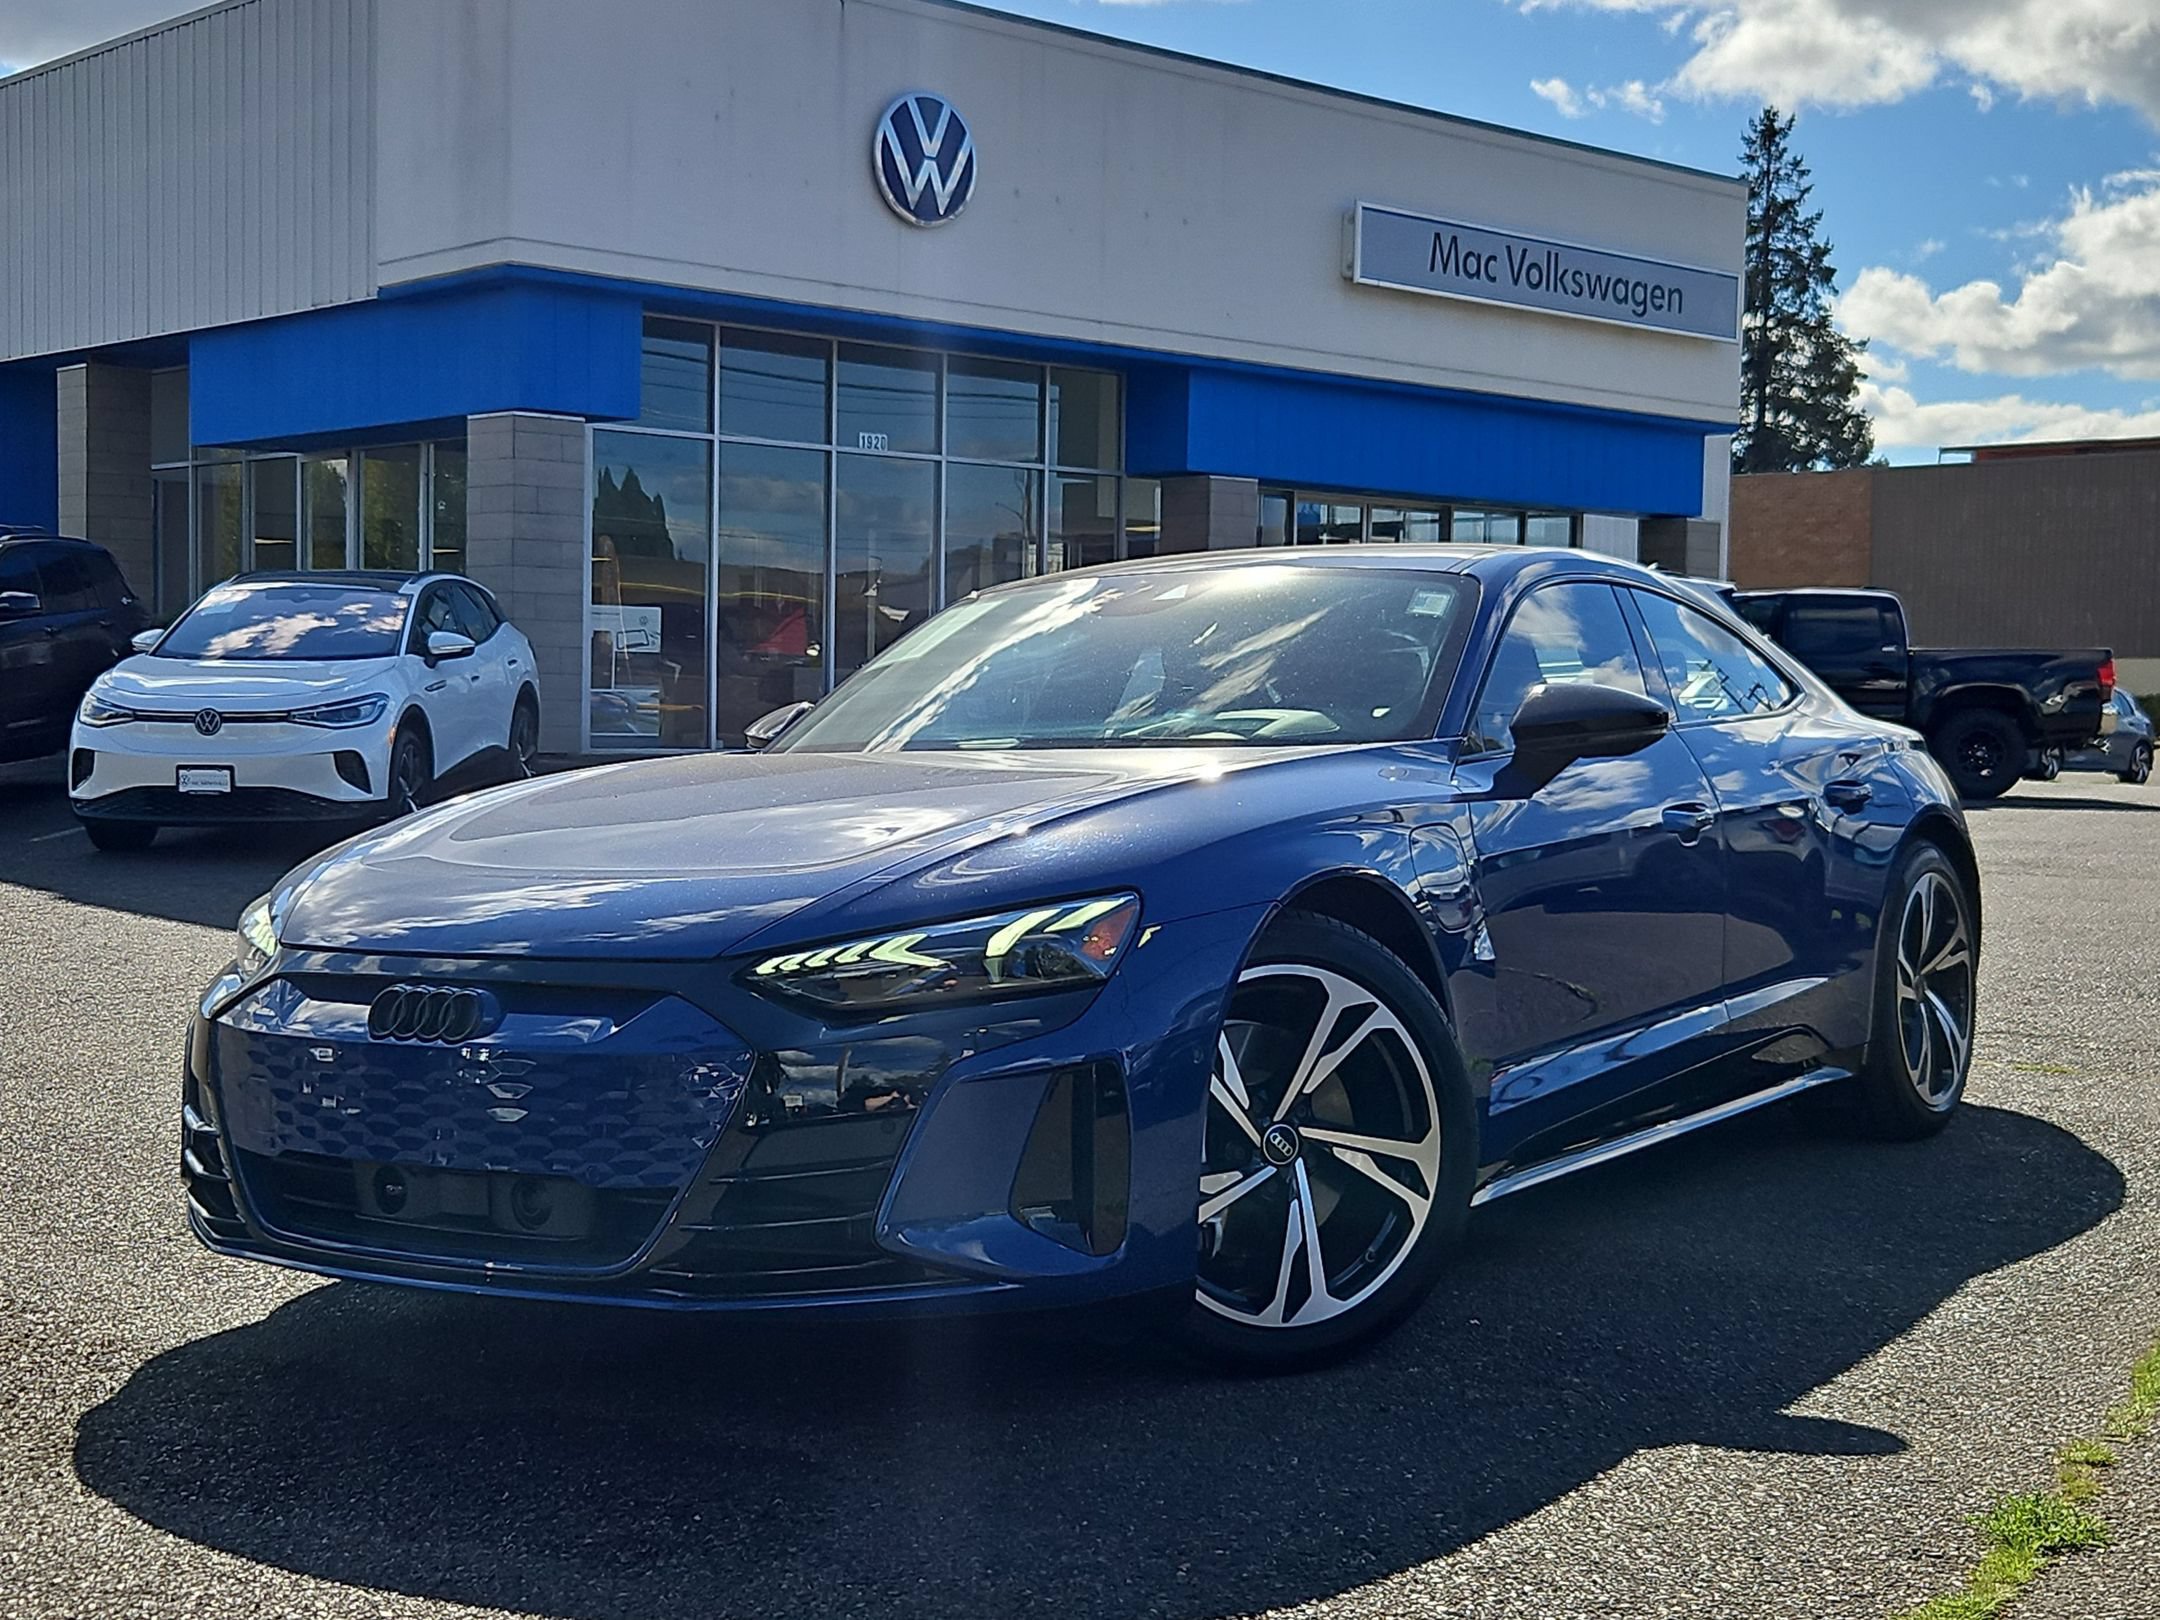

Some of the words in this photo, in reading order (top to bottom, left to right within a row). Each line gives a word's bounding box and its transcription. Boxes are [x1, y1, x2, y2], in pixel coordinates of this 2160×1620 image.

[879, 95, 974, 217] VW
[1429, 231, 1498, 283] Mac
[1505, 245, 1683, 318] Volkswagen
[861, 435, 886, 450] 1920
